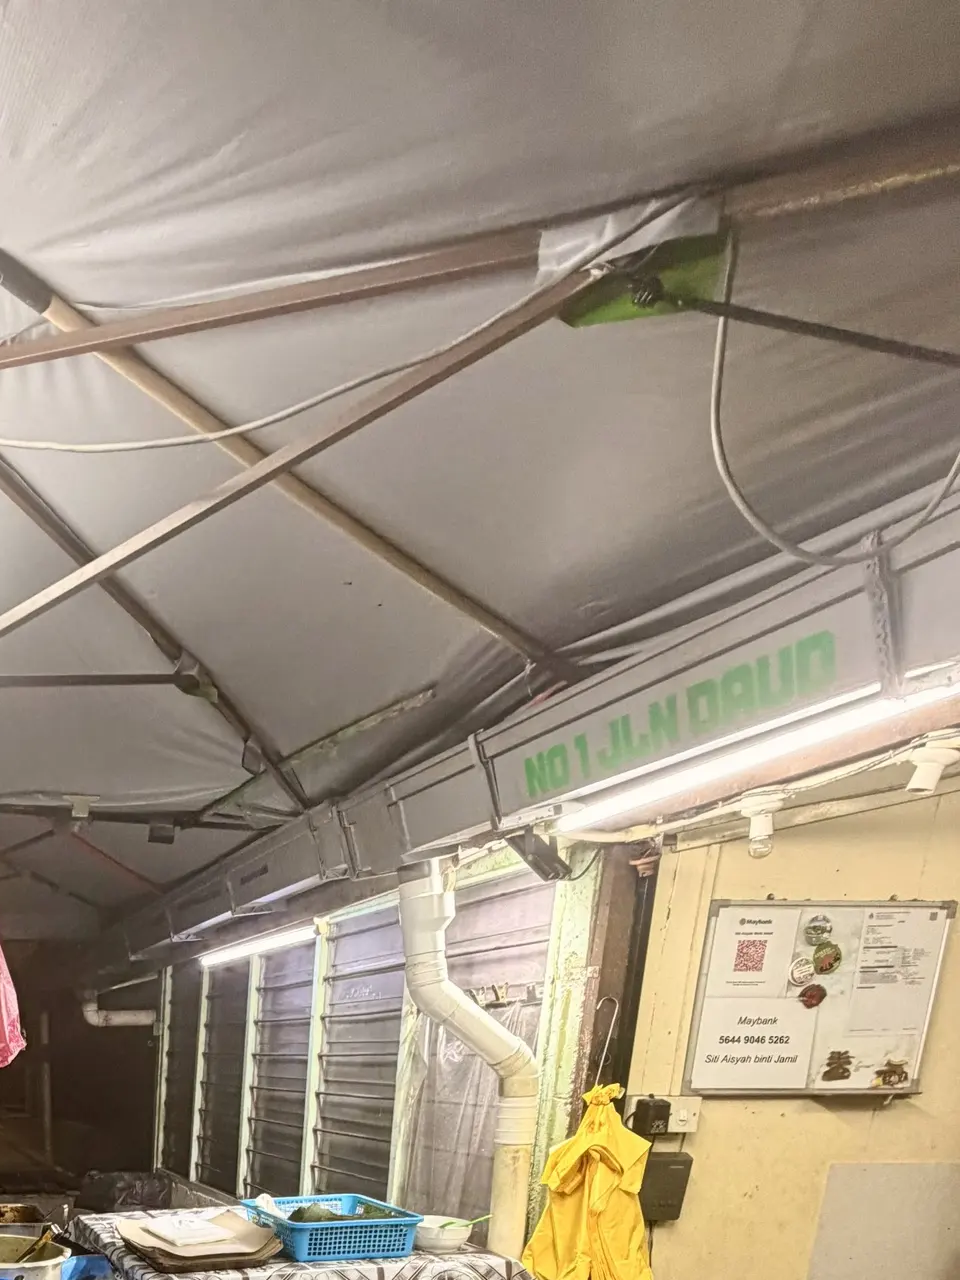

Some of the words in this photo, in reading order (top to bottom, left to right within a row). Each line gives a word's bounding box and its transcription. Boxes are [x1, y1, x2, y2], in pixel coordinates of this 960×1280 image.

[525, 743, 570, 797] NO
[574, 732, 589, 778] 1
[686, 629, 835, 734] DAUD
[737, 1016, 778, 1027] Maybank
[719, 1035, 741, 1044] 5644
[744, 1035, 766, 1044] 9046
[768, 1035, 790, 1044] 5262
[705, 1054, 720, 1064] Siti
[721, 1054, 752, 1065] Aisyah
[754, 1054, 773, 1063] binti
[774, 1054, 798, 1063] Jamil
